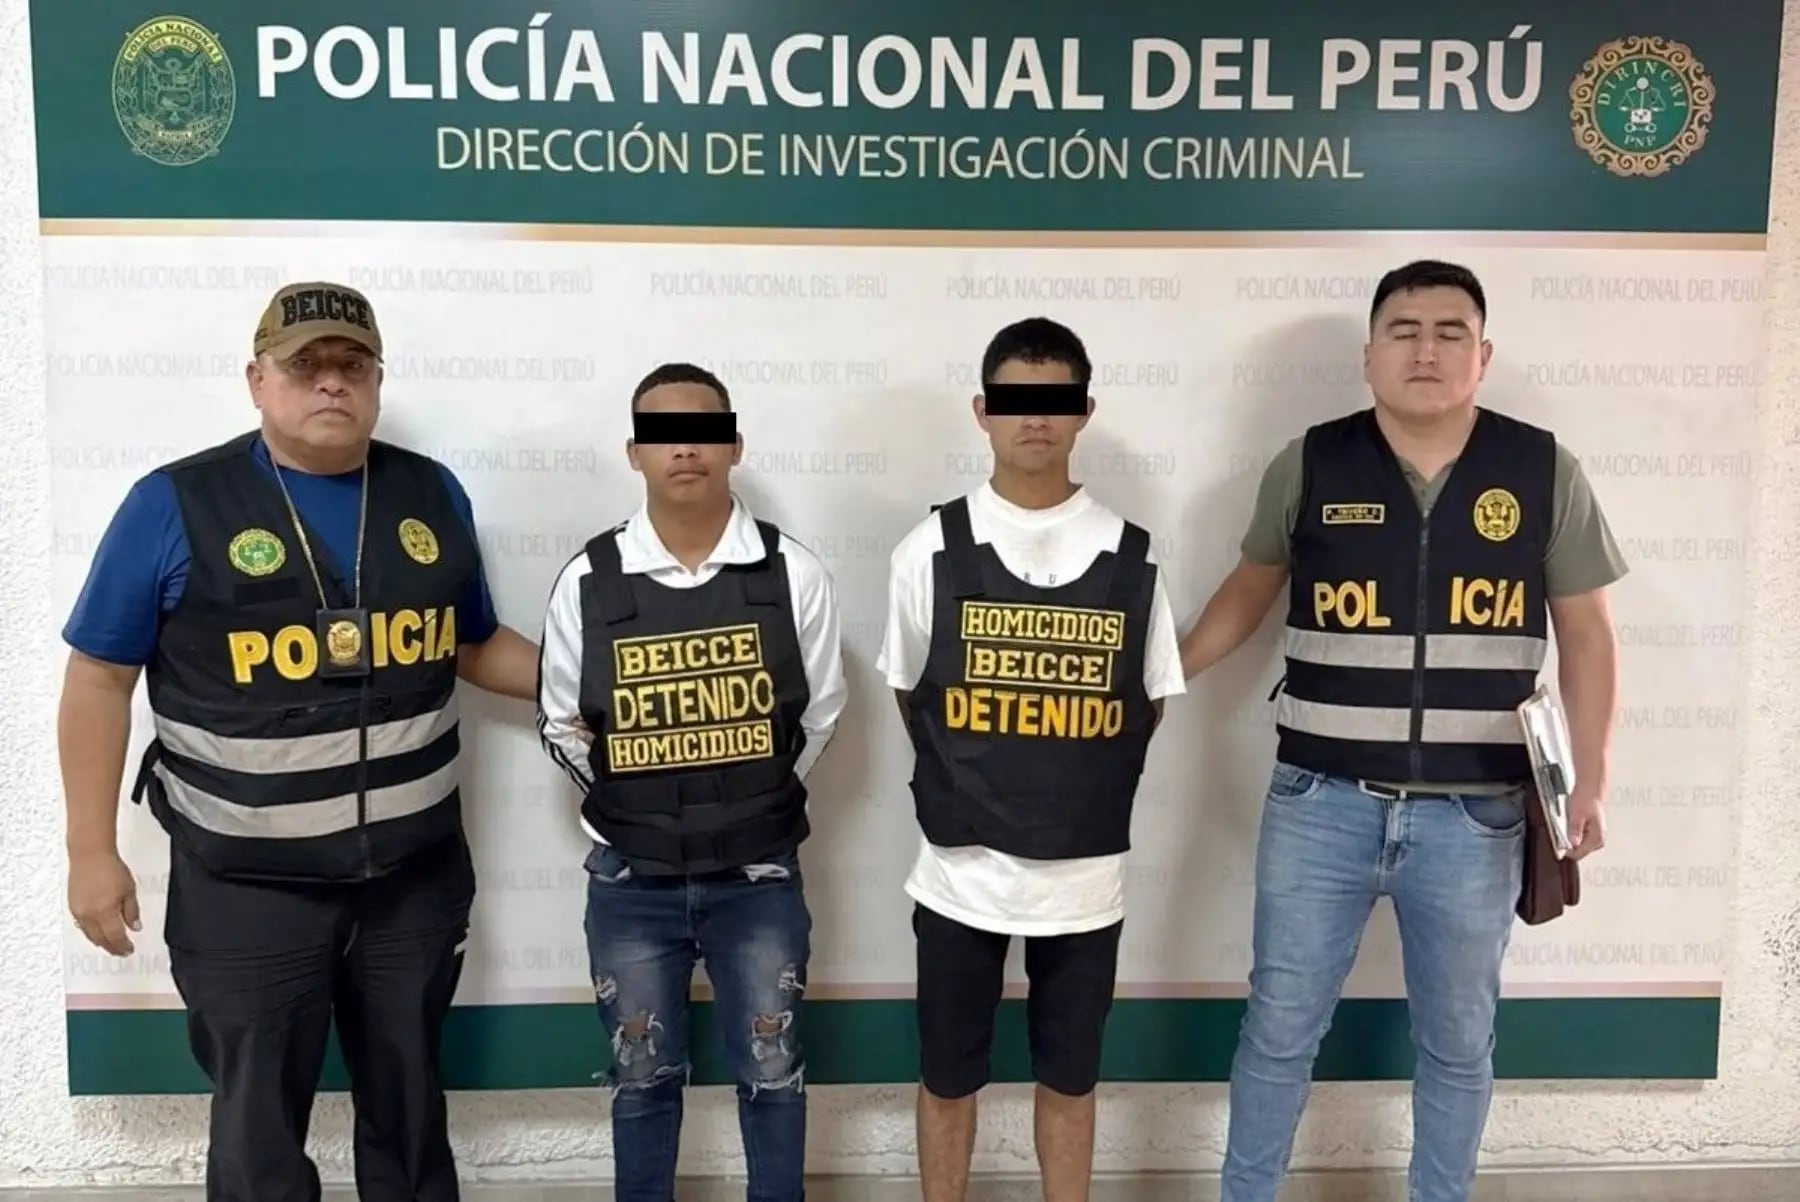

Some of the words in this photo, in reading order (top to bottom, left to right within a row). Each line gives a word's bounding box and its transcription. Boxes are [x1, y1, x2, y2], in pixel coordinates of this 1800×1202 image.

[166, 23, 221, 61] NACIONAL
[258, 13, 615, 103] POLICÍA
[642, 31, 1104, 110] NACIONAL
[1132, 38, 1294, 111] DEL
[1321, 25, 1542, 112] PERÚ
[1597, 60, 1687, 107] DIRINCRI
[437, 122, 689, 174] DIRECCIÓN
[706, 132, 765, 176] DE
[781, 129, 1128, 180] INVESTIGACIÓN
[1144, 136, 1364, 180] CRIMINAL
[1623, 133, 1656, 147] PNP
[113, 266, 204, 290] NACIONAL
[206, 266, 240, 290] DEL
[421, 269, 509, 294] NACIONAL
[514, 270, 546, 294] DEL
[550, 265, 593, 295] PERÚ
[650, 269, 716, 297] POLICÍA
[720, 273, 807, 298] NACIONAL
[810, 274, 841, 299] DEL
[846, 270, 888, 299] PERÚ
[946, 270, 1010, 300] POLICÍA
[1014, 276, 1098, 301] NACIONAL
[1104, 277, 1136, 301] DEL
[1139, 272, 1183, 301] PERÚ
[1236, 272, 1300, 300] POLICÍA
[1530, 273, 1594, 302] POLICÍA
[1598, 278, 1682, 302] NACIONAL
[1686, 278, 1716, 302] DEL
[281, 289, 370, 331] BEICCE
[117, 353, 208, 378] NACIONAL
[423, 356, 510, 379] NACIONAL
[515, 357, 548, 381] DEL
[811, 361, 838, 384] DEL
[1103, 363, 1136, 386] DEL
[1527, 358, 1591, 387] POLICÍA
[1594, 363, 1678, 387] NACIONAL
[1682, 364, 1712, 387] DEL
[518, 448, 551, 472] DEL
[811, 451, 840, 475] DEL
[1590, 453, 1672, 477] NACIONAL
[1678, 454, 1706, 477] DEL
[519, 534, 552, 557] DEL
[1672, 538, 1701, 561] DEL
[966, 606, 1120, 644] HOMICIDIOS
[227, 606, 457, 684] POICÍA
[620, 632, 757, 677] BEICCE
[972, 647, 1105, 684] BEICCE
[612, 671, 775, 731] DETENIDO
[945, 687, 1123, 739] DETENIDO
[612, 724, 769, 767] HOMICIDIOS
[1655, 866, 1684, 888] DEL
[1566, 943, 1644, 967] NACIONAL
[1649, 943, 1678, 967] DEL
